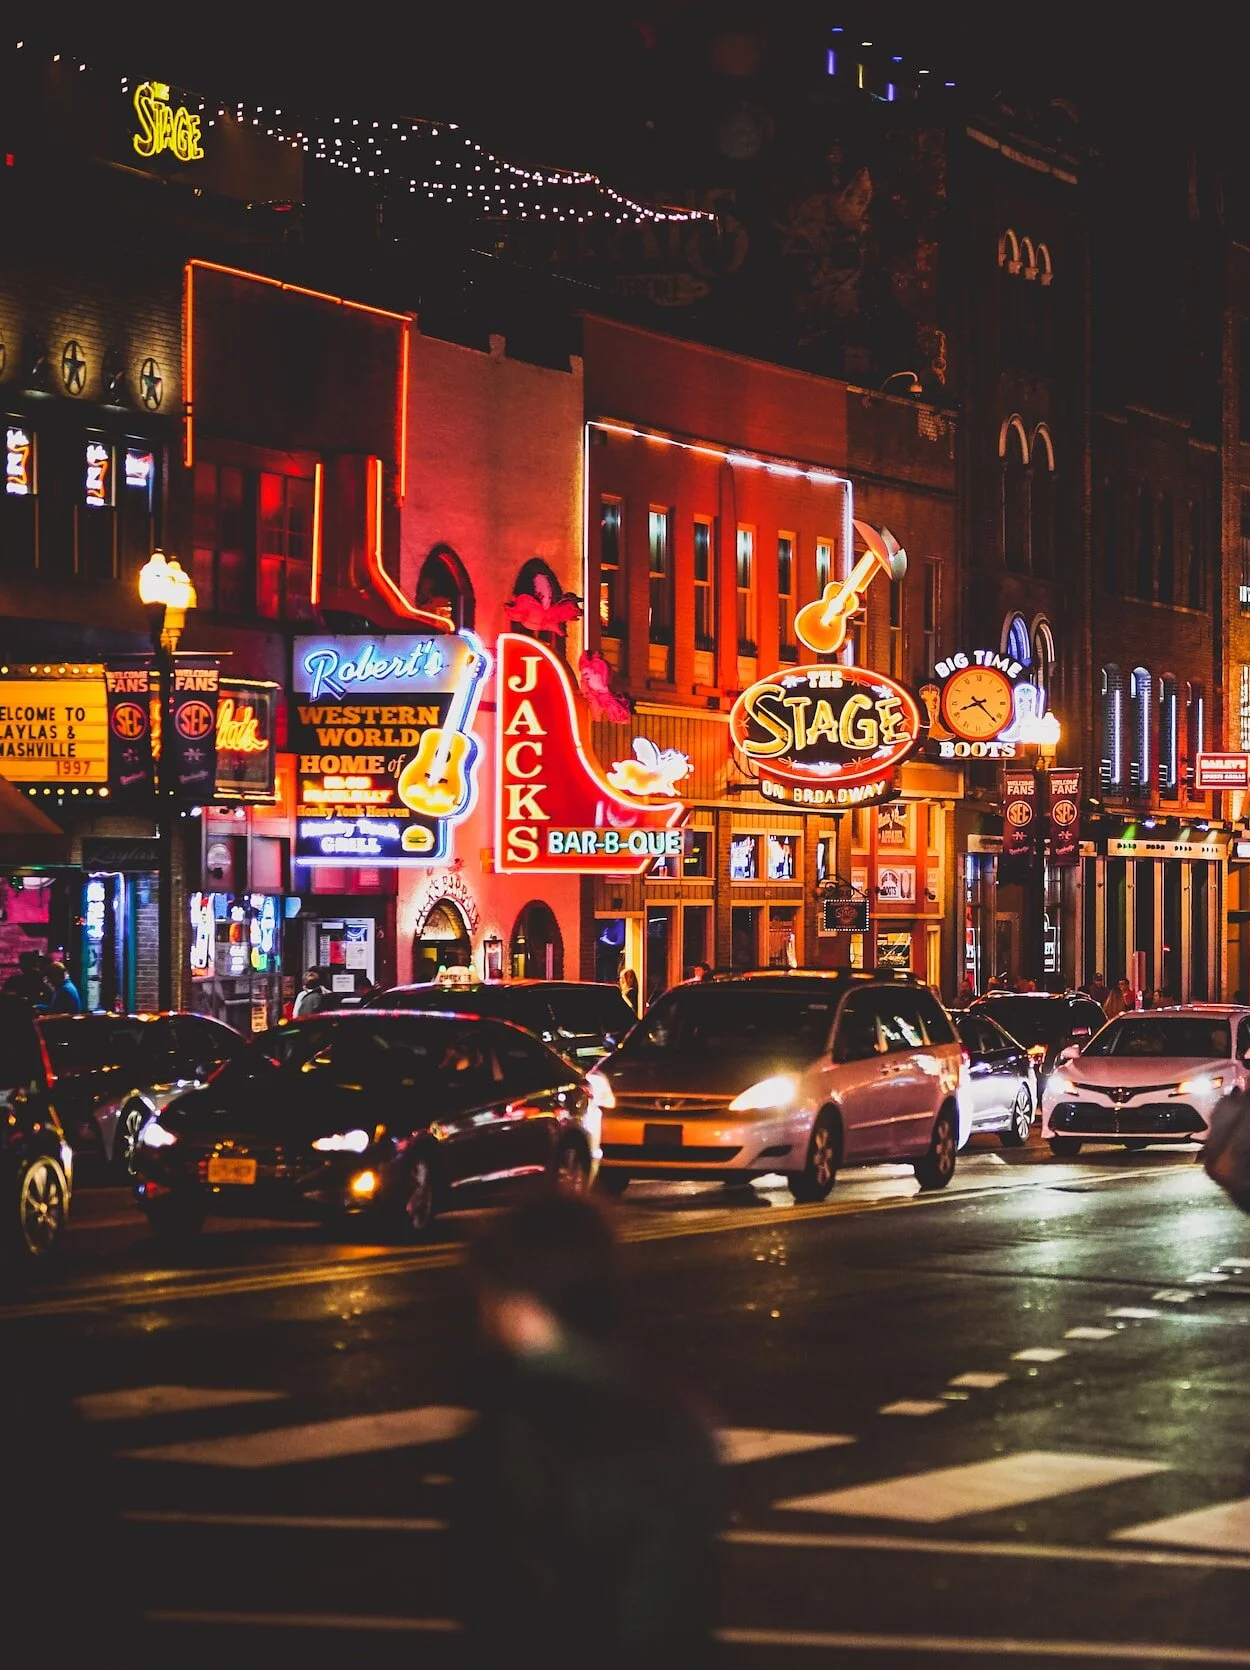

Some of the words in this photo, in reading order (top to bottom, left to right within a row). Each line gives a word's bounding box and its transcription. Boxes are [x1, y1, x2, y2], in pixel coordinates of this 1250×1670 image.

[132, 84, 205, 161] STAGE
[175, 669, 219, 678] WELCOME
[304, 639, 446, 701] Robert's
[934, 652, 970, 678] BIG
[973, 650, 1023, 678] TIME
[106, 671, 148, 679] WELCOME
[175, 677, 219, 692] FANS
[807, 671, 844, 689] THE
[107, 679, 149, 692] FANS
[0, 707, 55, 721] ELCOME
[65, 707, 85, 722] TO
[115, 706, 144, 736] SEC
[179, 704, 210, 736] SEC
[298, 706, 440, 726] WESTERN
[742, 683, 912, 759] STAGE
[0, 724, 57, 739] AYLAS
[67, 725, 75, 739] &
[316, 728, 421, 748] WORLD
[504, 656, 551, 863] JACKS
[939, 742, 1016, 758] BOOTS
[56, 760, 90, 775] 1997
[301, 755, 385, 774] HOME
[388, 754, 405, 779] of
[762, 780, 784, 799] ON
[793, 781, 886, 804] BROADWAY
[1007, 785, 1036, 795] FANS
[1051, 784, 1079, 795] FANS
[297, 806, 335, 818] Honky
[335, 804, 364, 816] Tonk
[366, 806, 410, 818] Heaven
[1009, 803, 1030, 824] SEC
[549, 830, 682, 855] BAR-B-QUE
